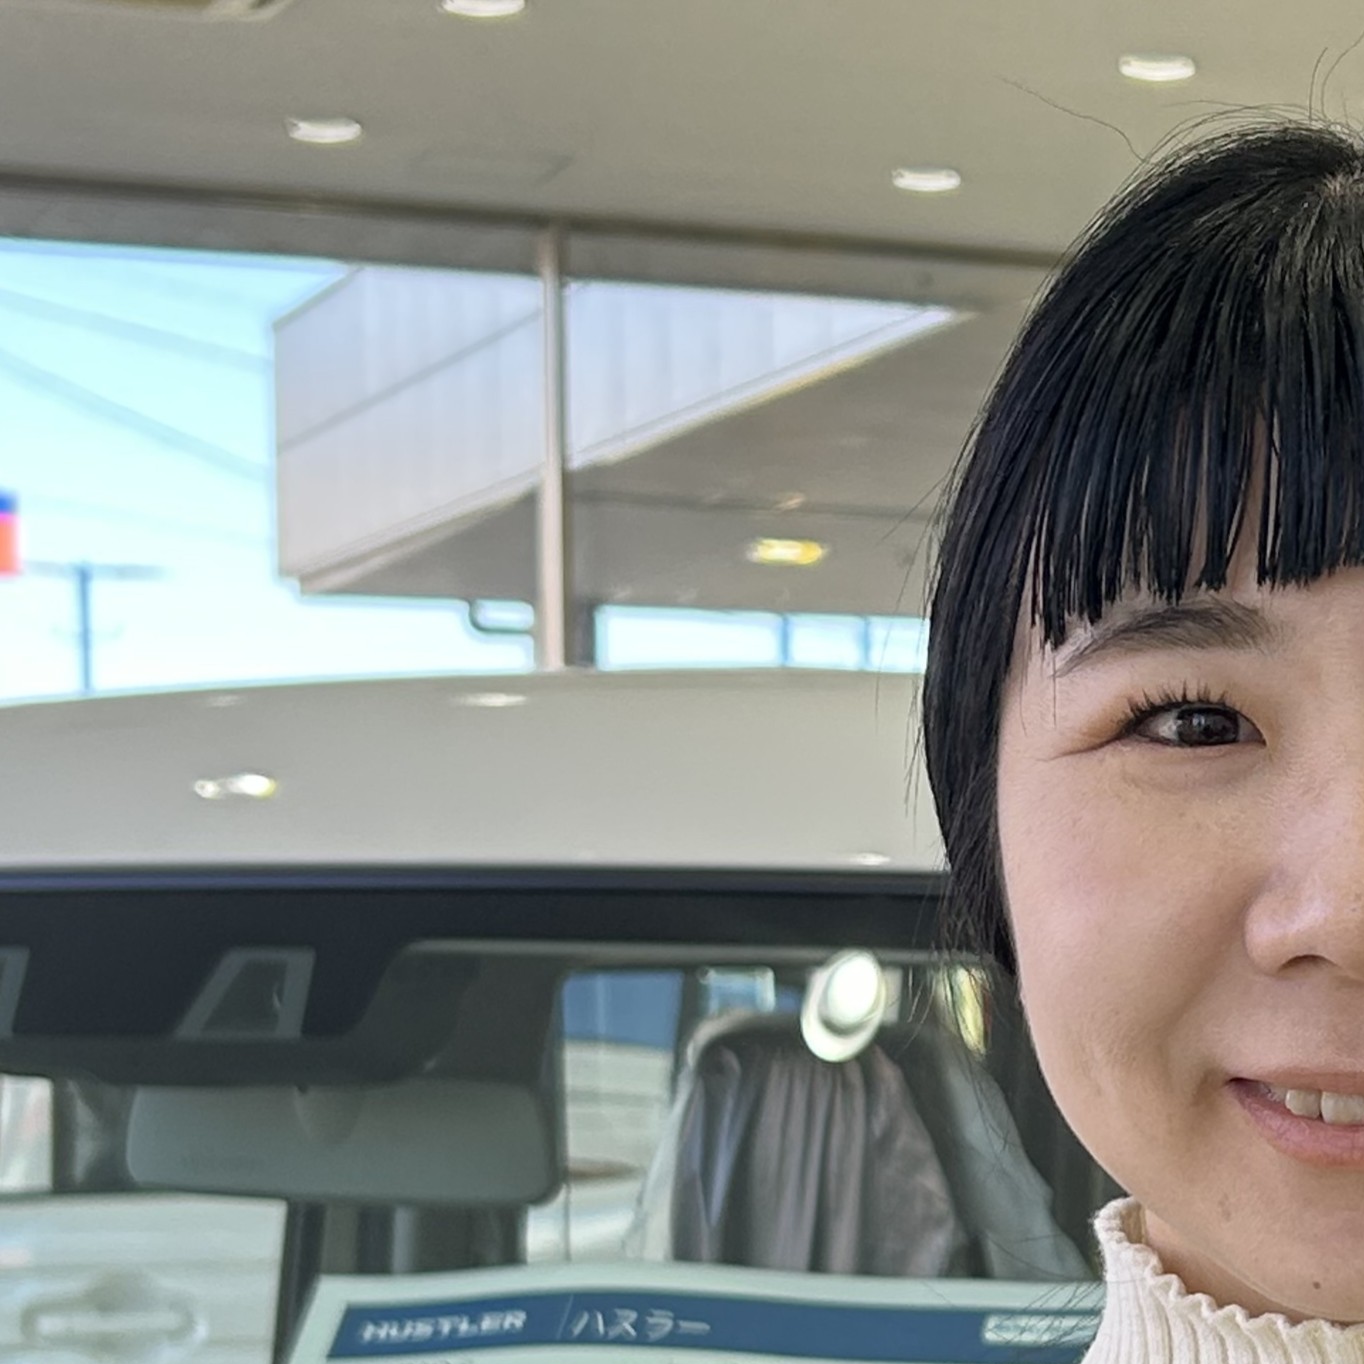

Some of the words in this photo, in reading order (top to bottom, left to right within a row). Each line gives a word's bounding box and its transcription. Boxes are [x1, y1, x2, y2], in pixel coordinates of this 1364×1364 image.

[361, 1309, 527, 1343] HUSTLER
[571, 1309, 711, 1342] ハスラー
